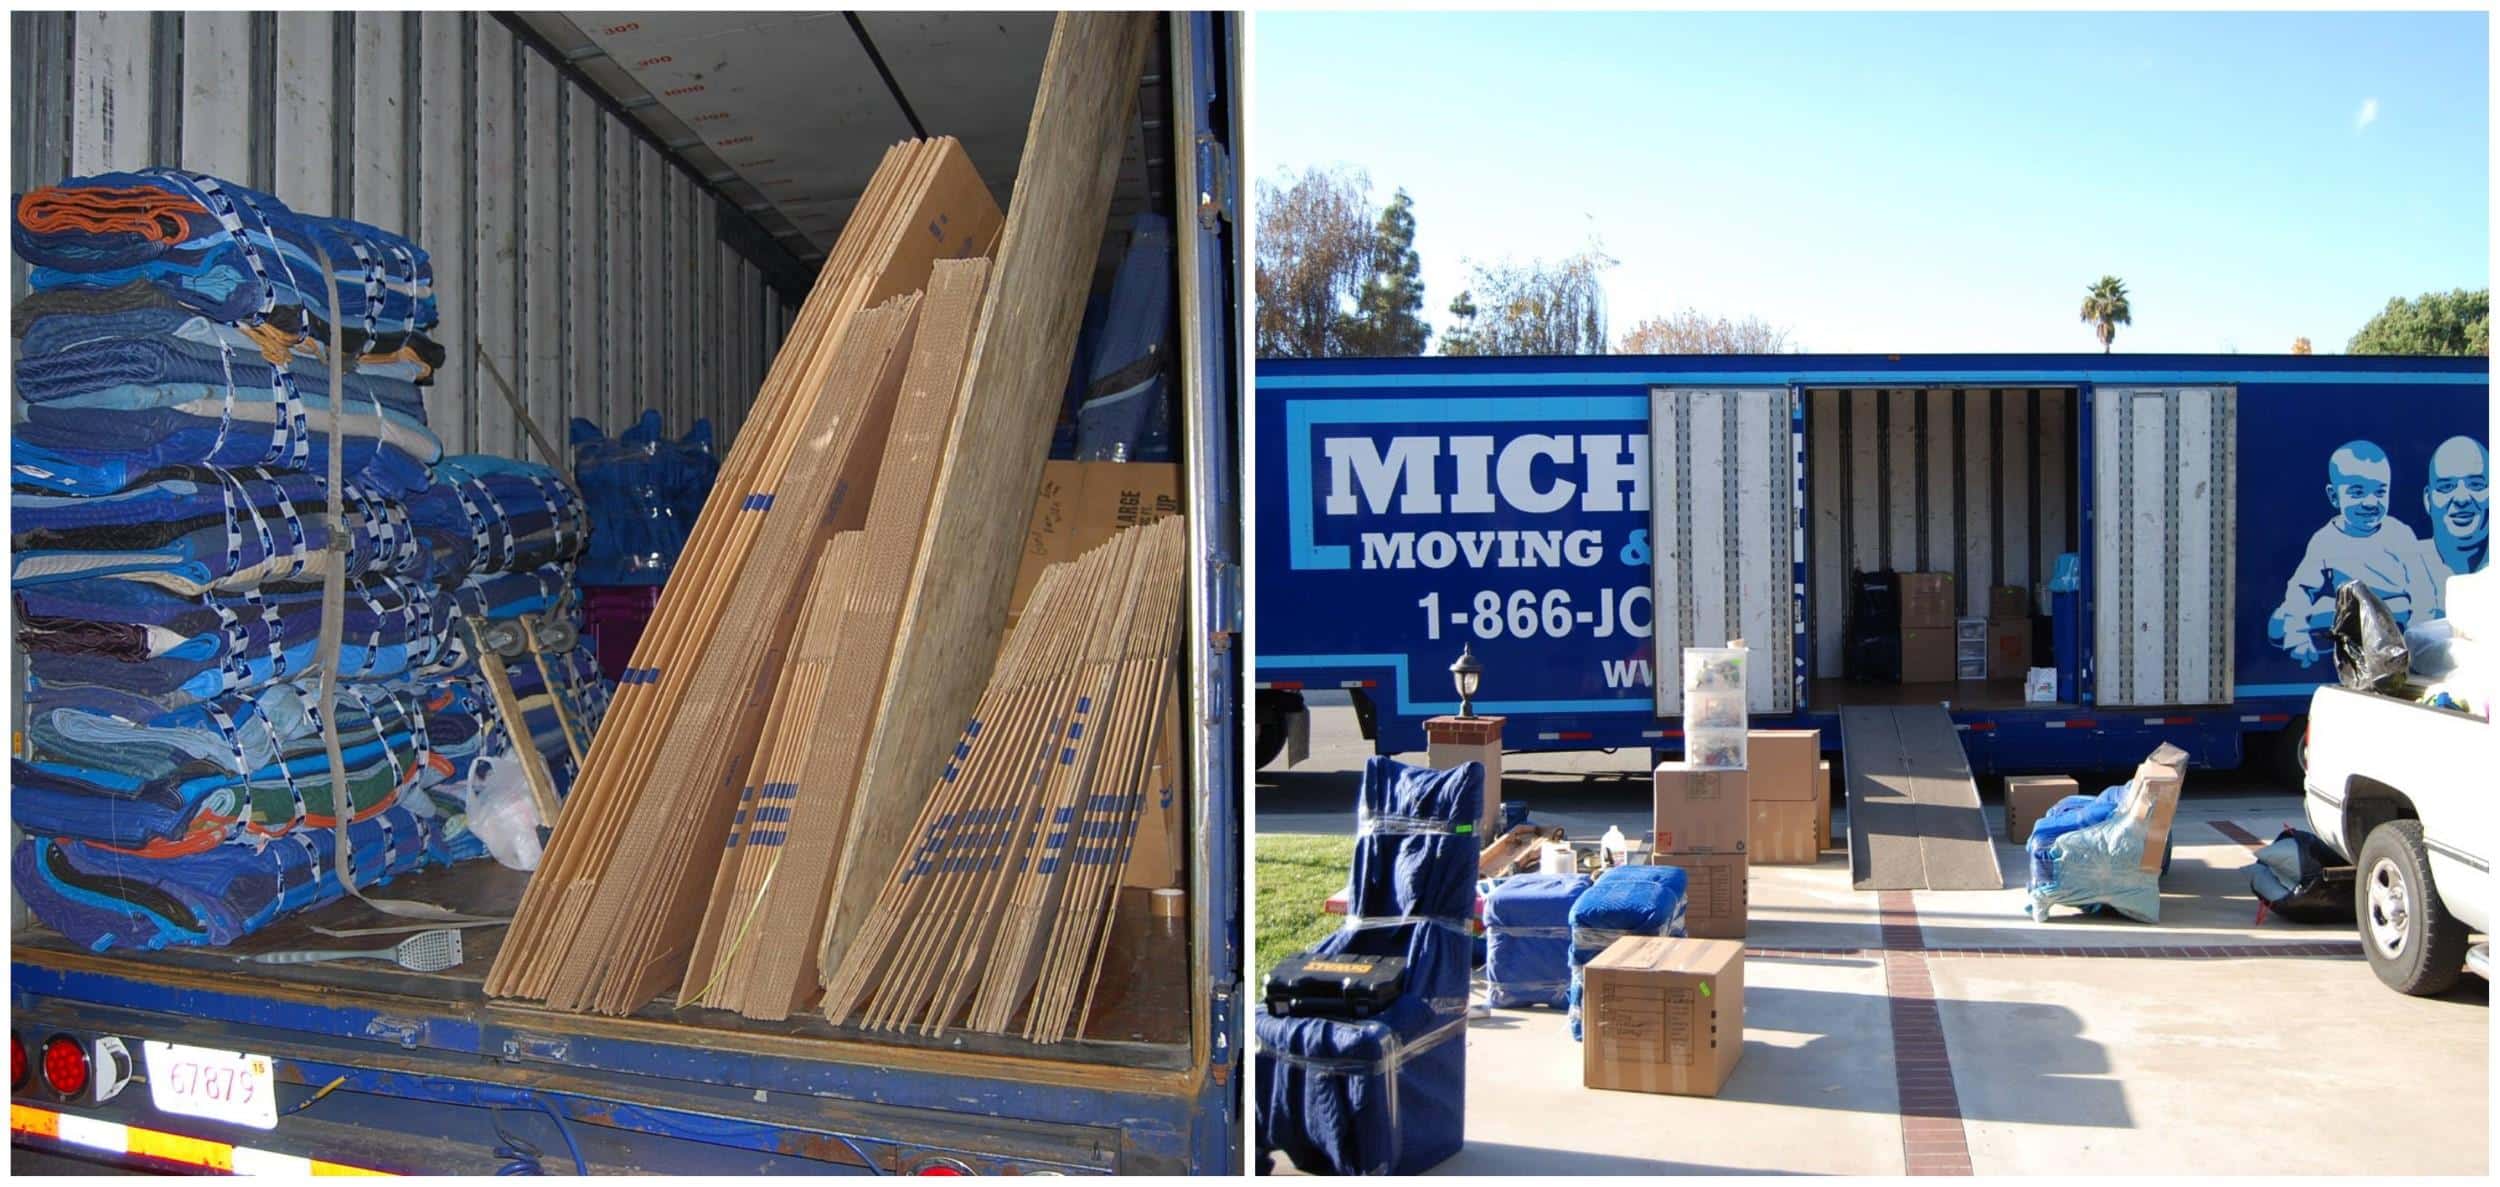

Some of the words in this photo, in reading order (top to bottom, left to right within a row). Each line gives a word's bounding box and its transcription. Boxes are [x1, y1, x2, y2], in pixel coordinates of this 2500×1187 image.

[1156, 494, 1177, 512] UP
[1361, 530, 1603, 569] MOVING
[252, 1062, 265, 1074] 15
[171, 1062, 255, 1104] 67879
